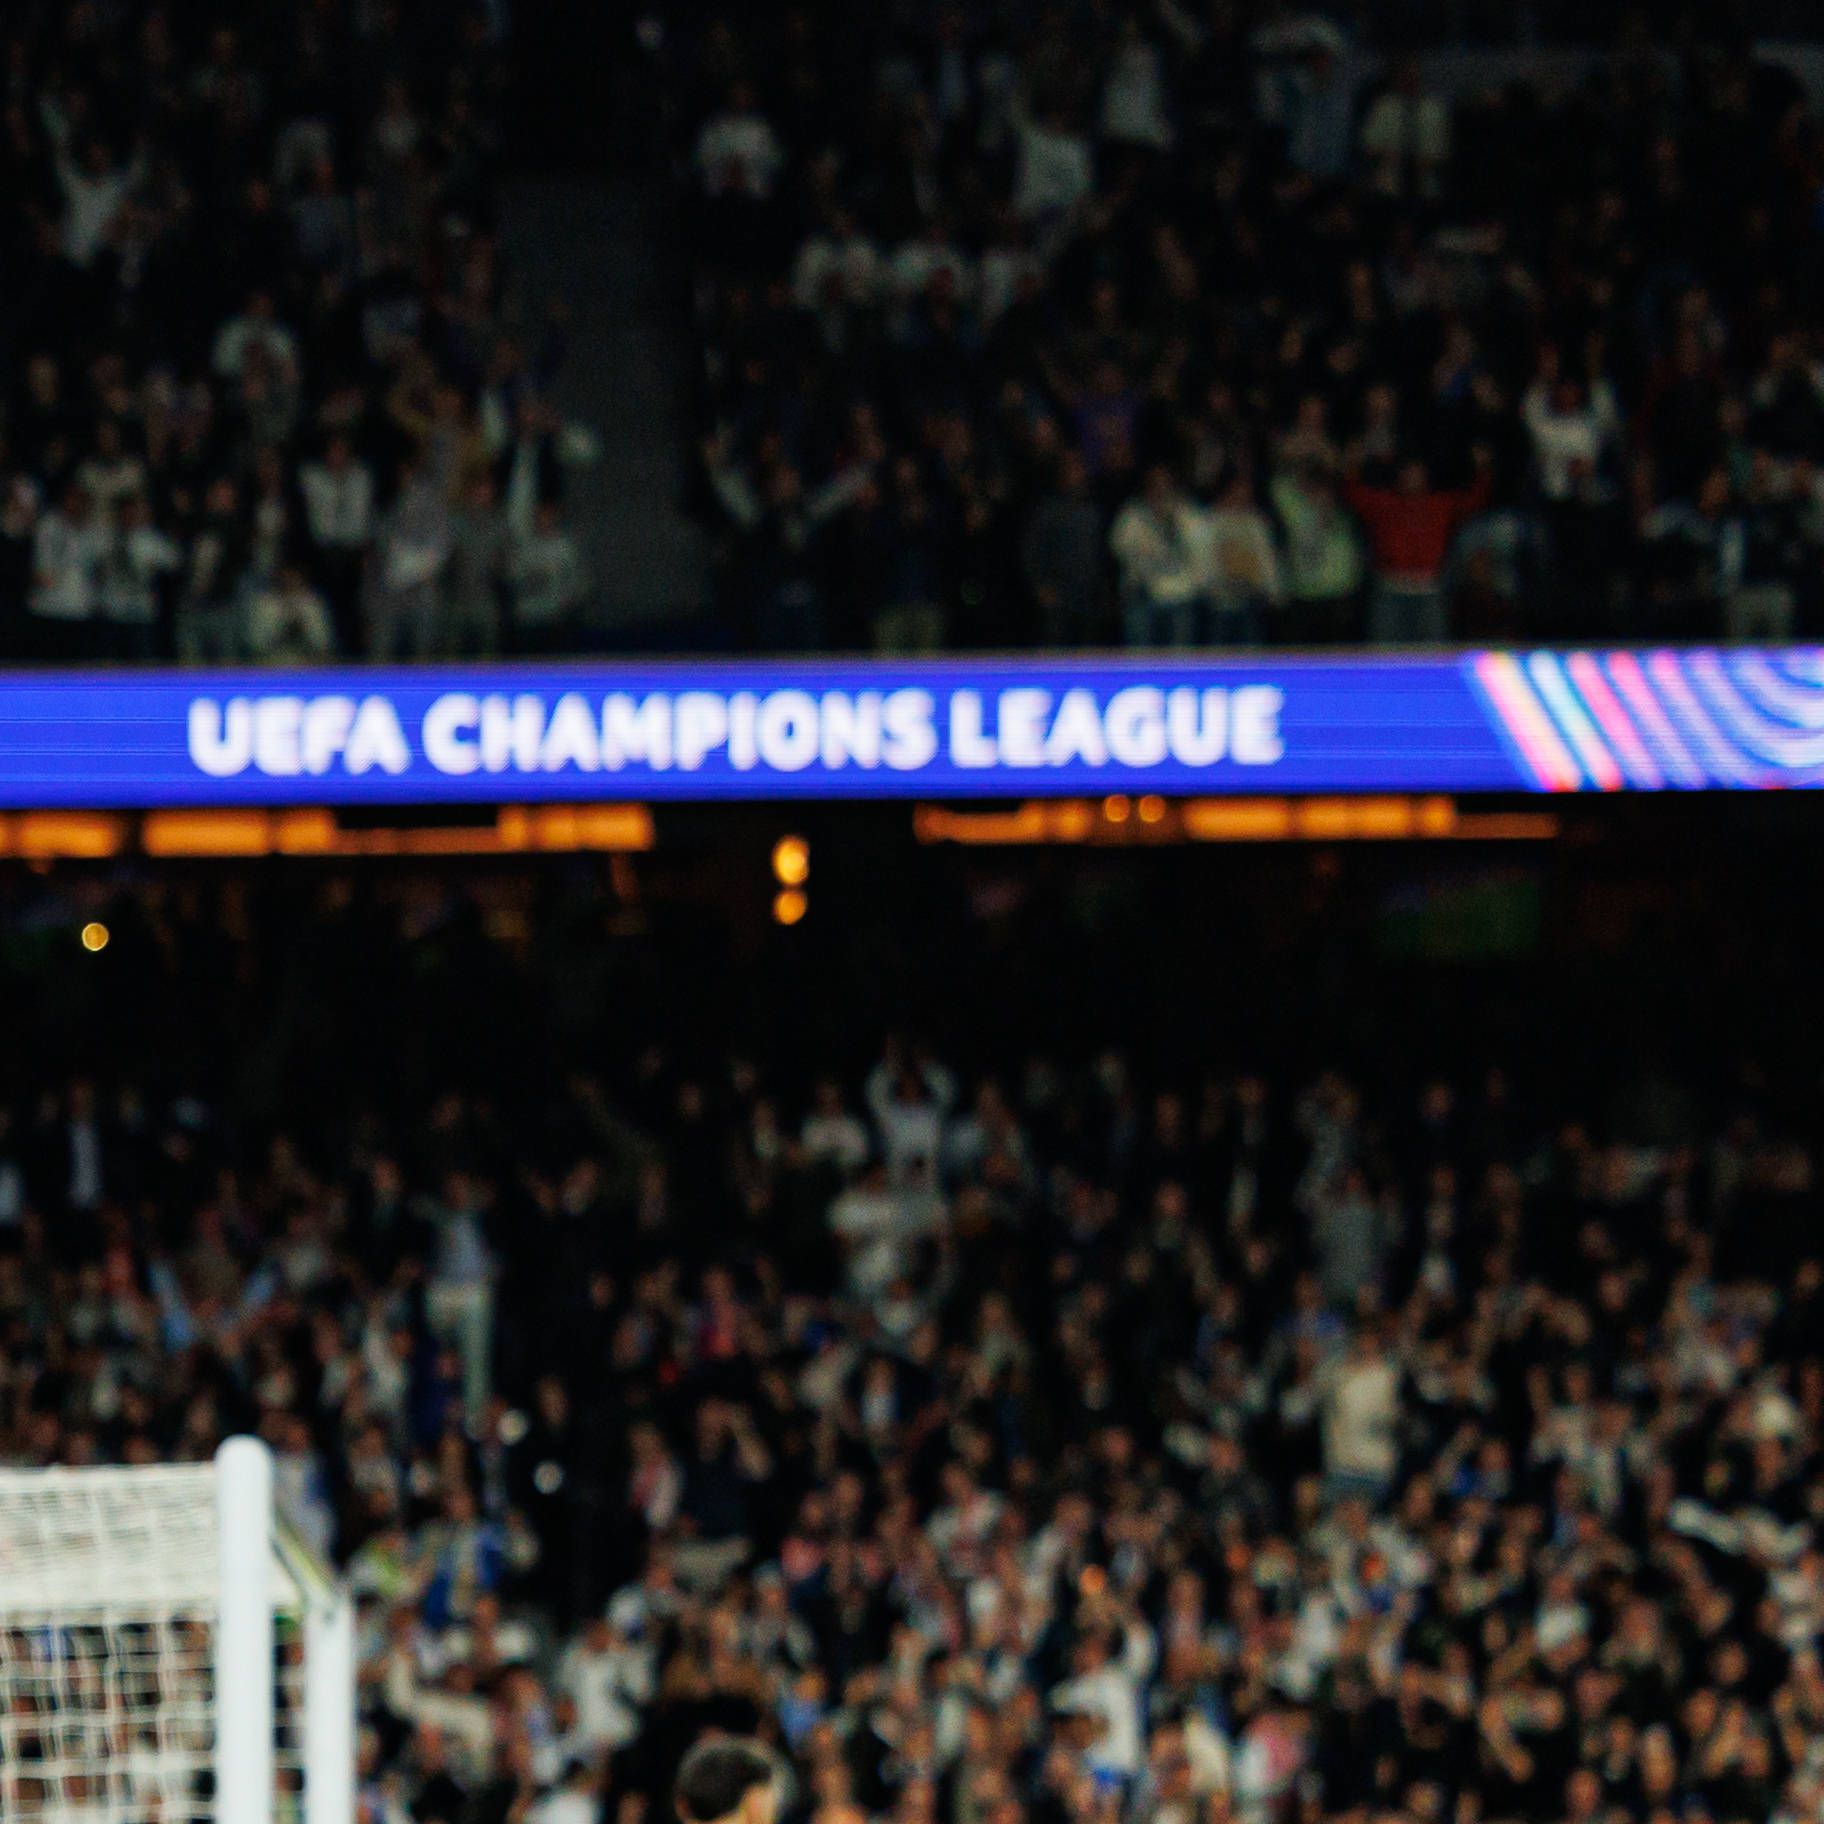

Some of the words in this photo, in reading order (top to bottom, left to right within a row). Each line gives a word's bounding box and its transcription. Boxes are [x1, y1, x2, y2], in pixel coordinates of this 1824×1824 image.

[187, 694, 410, 776] UEFA
[421, 689, 939, 775] CHAMPIONS
[948, 685, 1285, 768] LEAGUE
